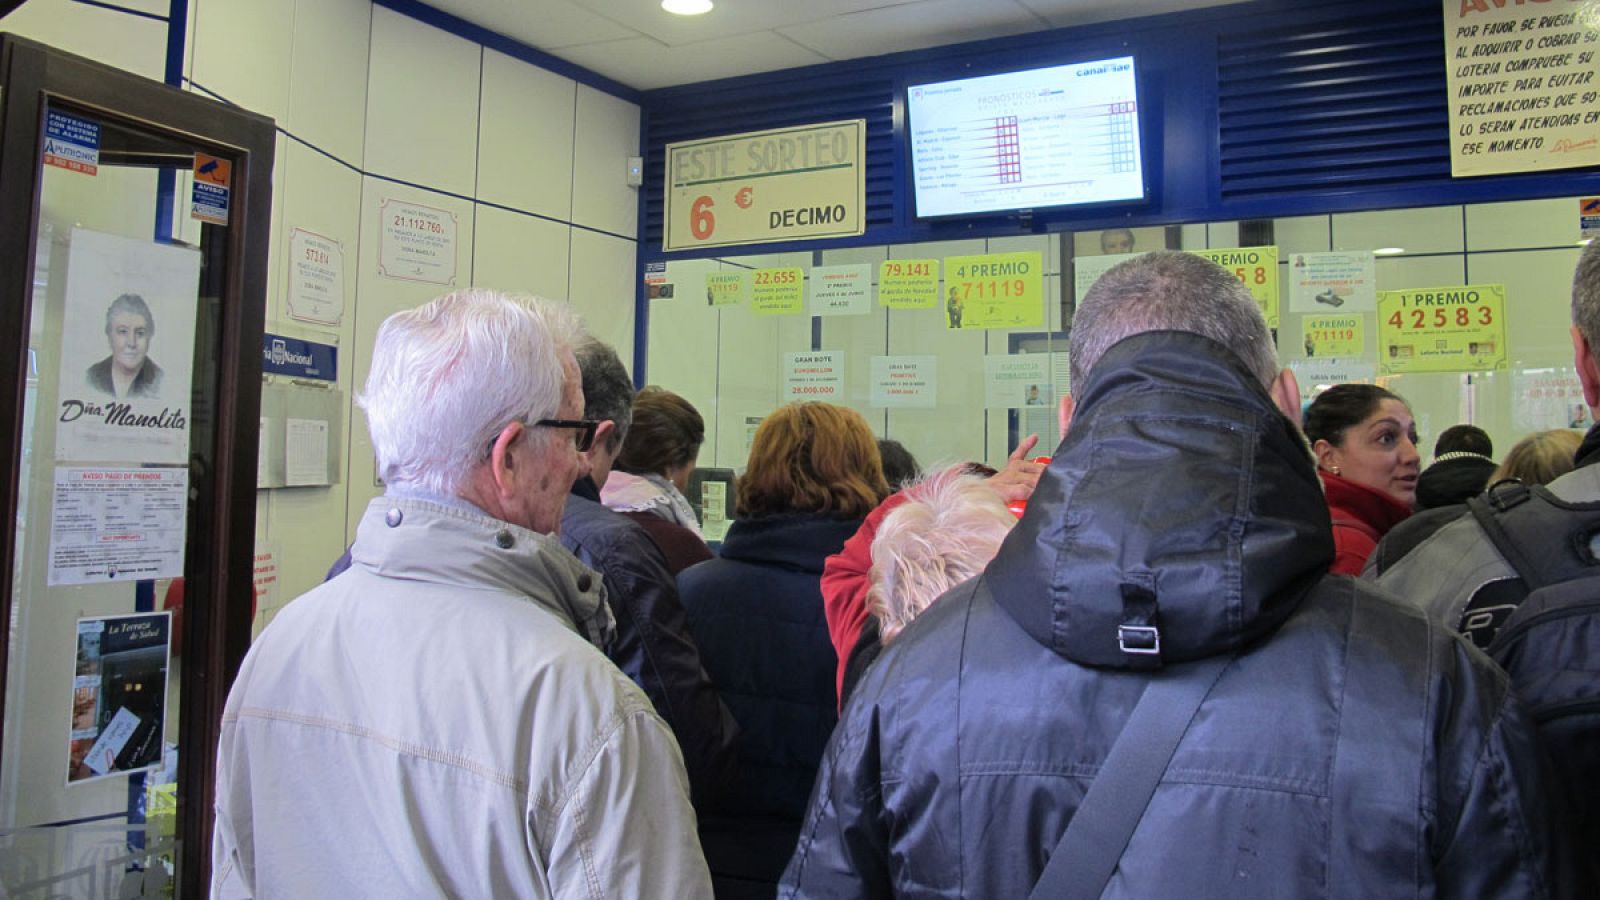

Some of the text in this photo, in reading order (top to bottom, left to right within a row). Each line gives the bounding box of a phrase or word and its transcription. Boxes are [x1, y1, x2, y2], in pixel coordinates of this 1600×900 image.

[1456, 25, 1479, 38] POR
[1520, 18, 1536, 31] SE
[1538, 13, 1576, 28] RUEGA
[1456, 31, 1599, 59] AL ADQUIRIR O COBRAR SU
[1456, 51, 1595, 78] LOTERIA COMPRUEBE SU
[1459, 71, 1594, 98] IMPORTE PARA EVITAR
[1459, 96, 1551, 116] RECLAMACIONES
[1554, 93, 1577, 109] QUE
[1460, 111, 1600, 136] LO SERAN ATENDIDAS EN
[674, 131, 849, 182] ESTE SORTEO
[1461, 142, 1483, 155] ESE
[197, 184, 224, 195] AVISO
[690, 187, 846, 240] 6 € DECIMO
[1207, 252, 1259, 265] REMIO
[886, 263, 930, 277] 79.141
[972, 261, 1029, 277] PREMIO
[755, 271, 796, 285] 22.655
[962, 280, 1025, 299] 71119
[1415, 290, 1480, 306] PREMIO
[1319, 319, 1356, 329] PREMIO
[1388, 306, 1493, 329] 42583
[285, 351, 313, 366] Nacional
[814, 355, 832, 363] BOTE
[104, 402, 186, 430] Manolita
[82, 471, 103, 480] AVISO
